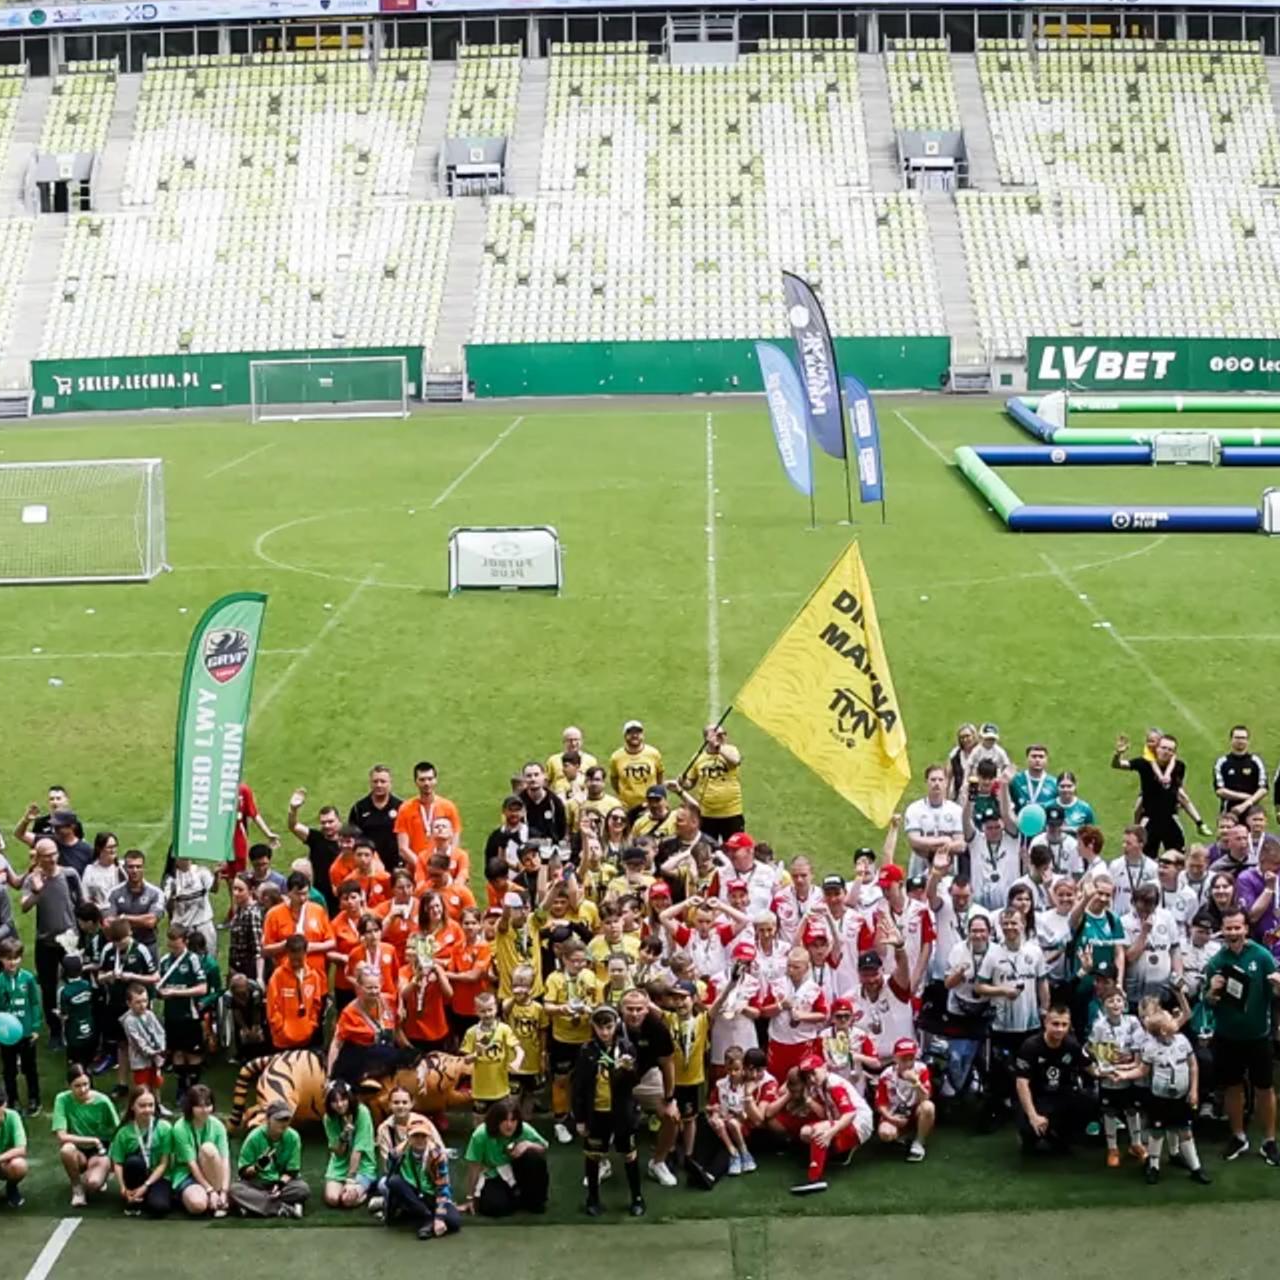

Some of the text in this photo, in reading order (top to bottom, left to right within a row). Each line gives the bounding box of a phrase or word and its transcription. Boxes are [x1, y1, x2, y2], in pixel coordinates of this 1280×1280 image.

[77, 372, 200, 392] SKLEP.LECHIA.PL
[1038, 346, 1176, 380] LVBET
[188, 688, 218, 845] TURBO LWY
[218, 723, 244, 816] TORUŃ
